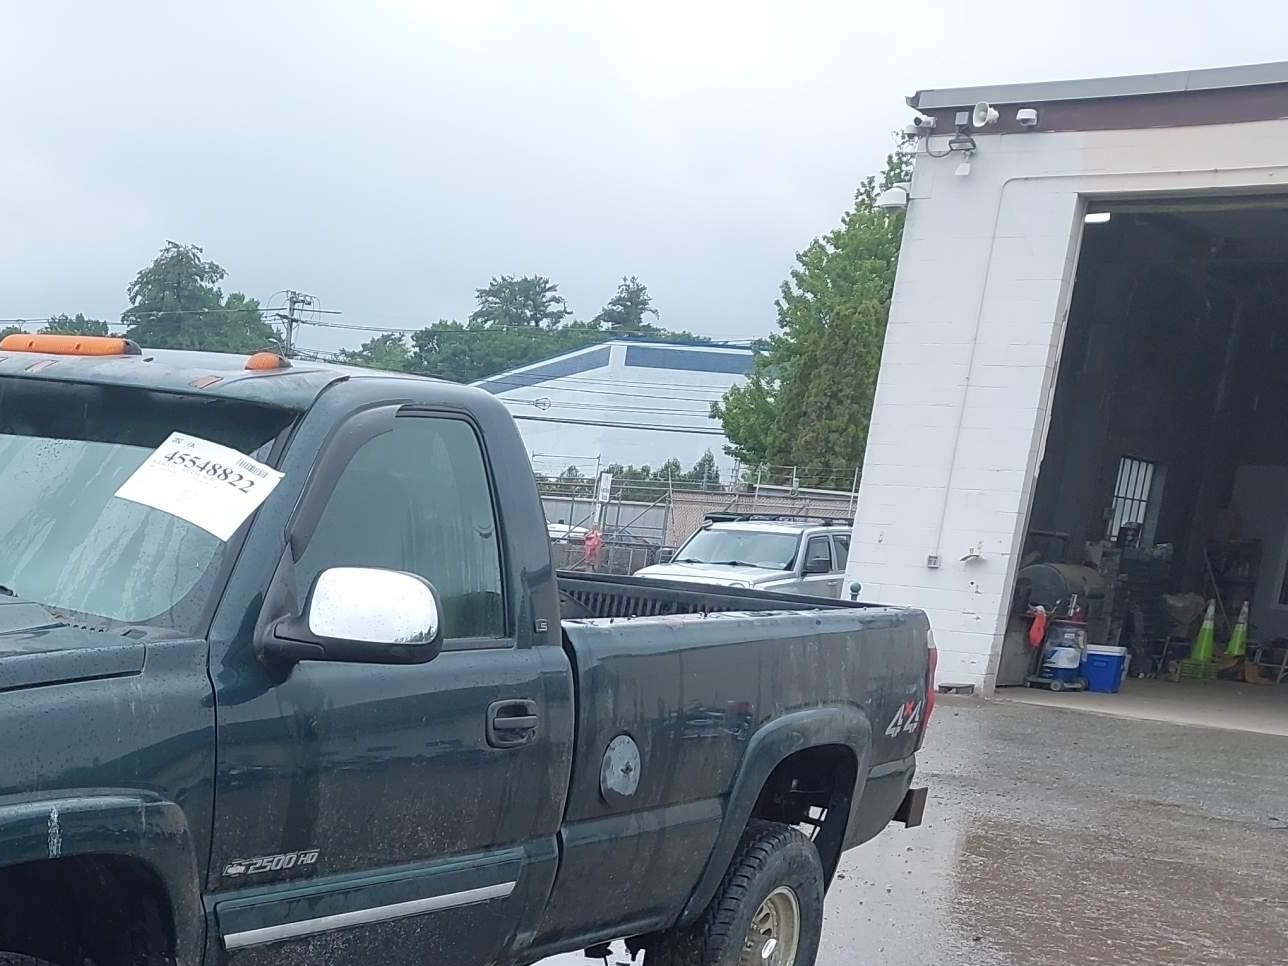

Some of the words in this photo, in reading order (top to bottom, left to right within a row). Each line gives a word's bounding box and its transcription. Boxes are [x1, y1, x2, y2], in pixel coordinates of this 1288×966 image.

[163, 450, 255, 494] 45548822
[247, 854, 298, 874] 2500
[298, 852, 318, 865] HD
